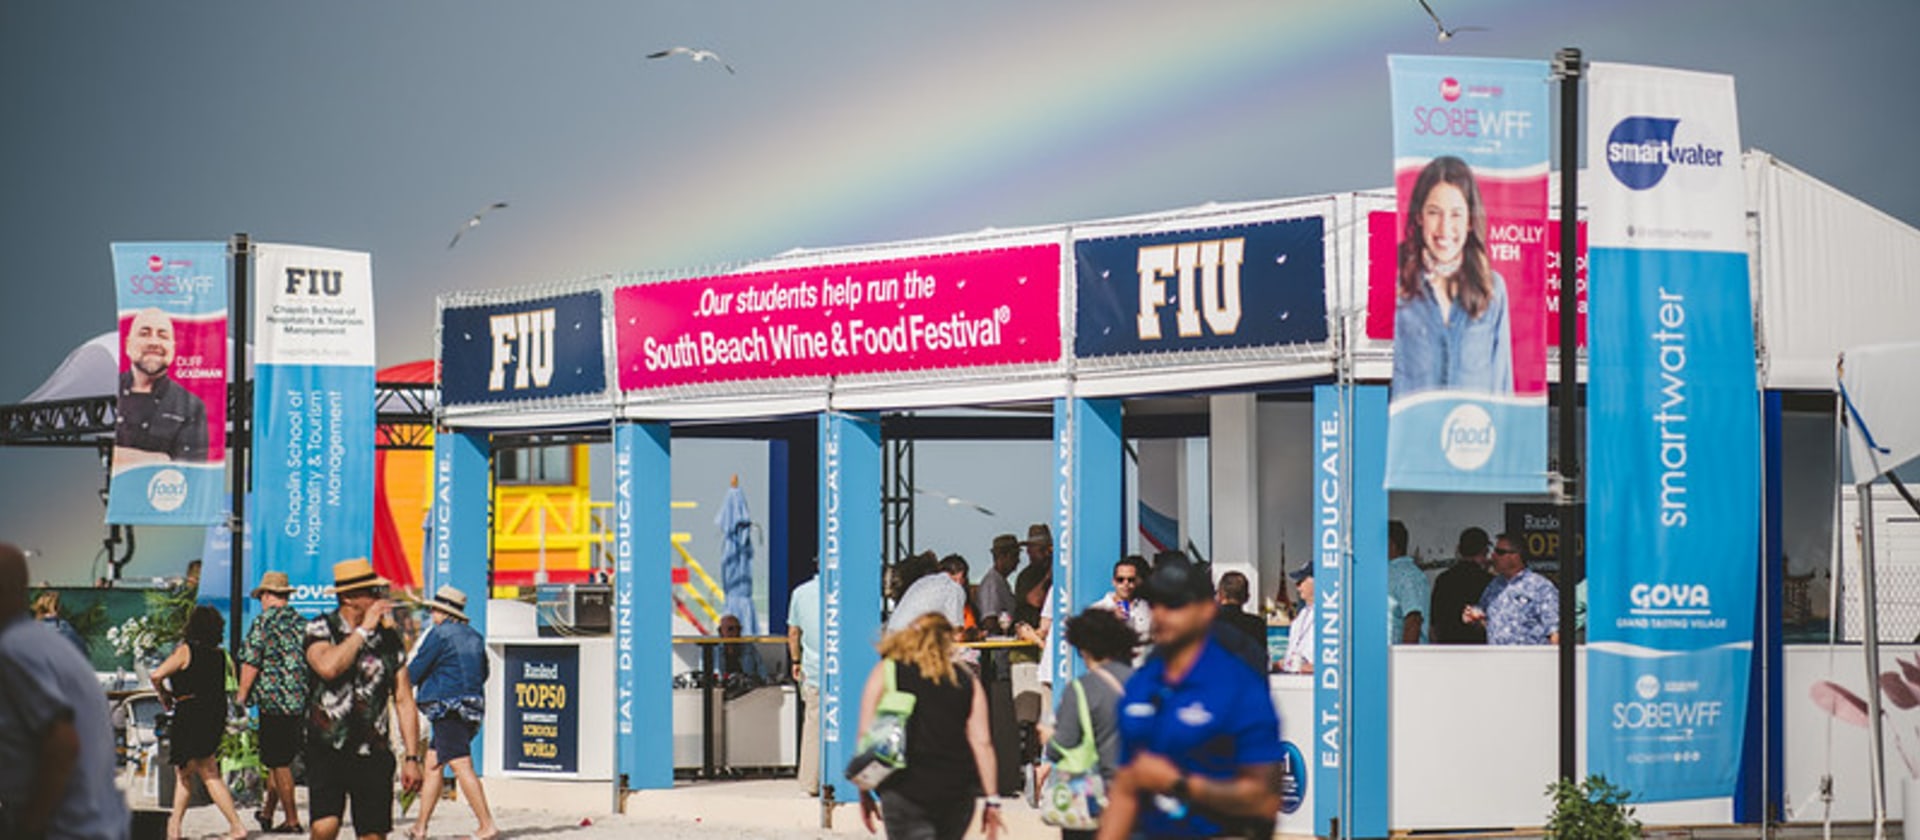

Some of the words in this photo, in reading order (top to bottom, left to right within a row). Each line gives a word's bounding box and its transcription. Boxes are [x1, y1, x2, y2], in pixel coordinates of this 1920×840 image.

[1413, 106, 1532, 138] SOBEWFF
[1608, 139, 1724, 167] smartwater
[1490, 225, 1543, 243] MOLLY
[1490, 243, 1520, 260] YEH
[129, 274, 214, 295] SOBEWFF
[285, 266, 343, 296] FIU
[700, 288, 733, 317] Our
[735, 281, 818, 314] students
[822, 275, 862, 311] help
[867, 278, 898, 303] run
[904, 269, 936, 299] the
[1137, 237, 1245, 340] FIU
[273, 305, 309, 316] Chaplin
[312, 305, 344, 316] School
[176, 355, 202, 367] DUFF
[489, 307, 556, 391] FIU
[644, 332, 699, 371] South
[700, 326, 768, 365] Beach
[769, 324, 828, 360] Wine
[831, 321, 848, 356] &
[849, 316, 908, 355] Food
[287, 389, 303, 408] of
[307, 391, 322, 450] Tourism
[1652, 286, 1687, 528] smartwater
[286, 411, 303, 467] School
[327, 391, 346, 506] Management
[1446, 418, 1492, 452] food
[306, 454, 321, 467] &
[285, 471, 304, 538] Chaplin
[304, 472, 324, 555] Hospitality
[619, 444, 632, 573] EDUCATE.
[1321, 411, 1339, 569] EDUCATE.
[1630, 583, 1710, 608] GOYA
[619, 581, 632, 671] DRINK.
[1321, 581, 1339, 690] DRINK.
[1616, 618, 1649, 628] GRAND
[1651, 618, 1688, 629] TASTING
[1690, 619, 1727, 629] VILLAGE
[515, 682, 566, 709] TOP50
[619, 681, 632, 735] EAT.
[1613, 701, 1722, 729] SOBEWFF
[1321, 702, 1339, 769] EAT.
